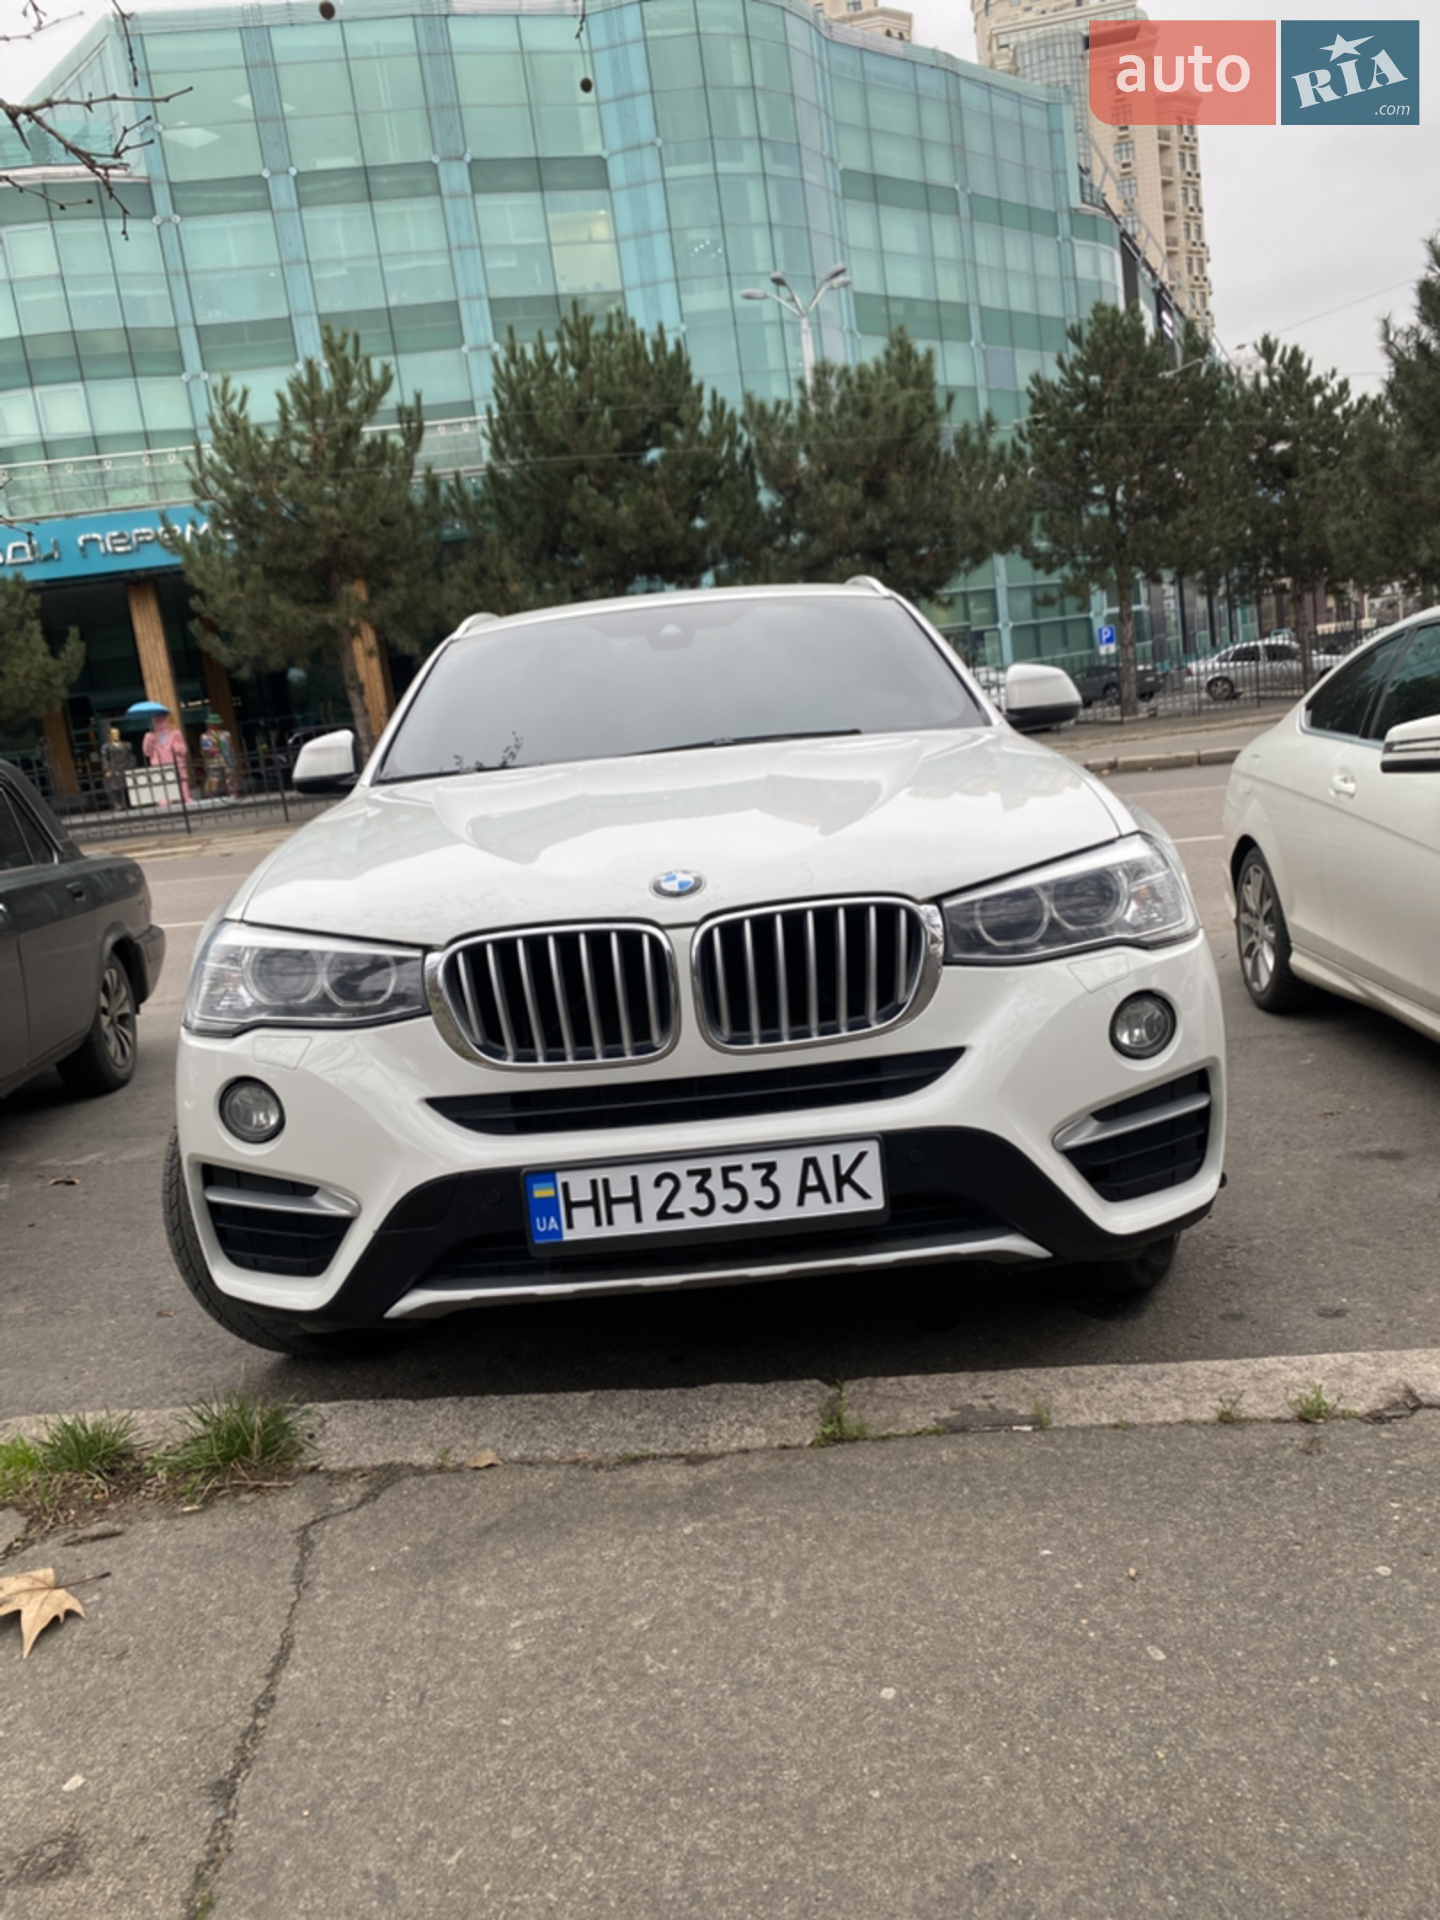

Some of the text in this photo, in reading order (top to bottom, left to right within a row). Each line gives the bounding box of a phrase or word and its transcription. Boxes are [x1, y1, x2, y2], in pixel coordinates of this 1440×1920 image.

[1101, 628, 1112, 644] P
[561, 1150, 873, 1230] HH 2353 AK
[535, 1216, 560, 1232] UA
